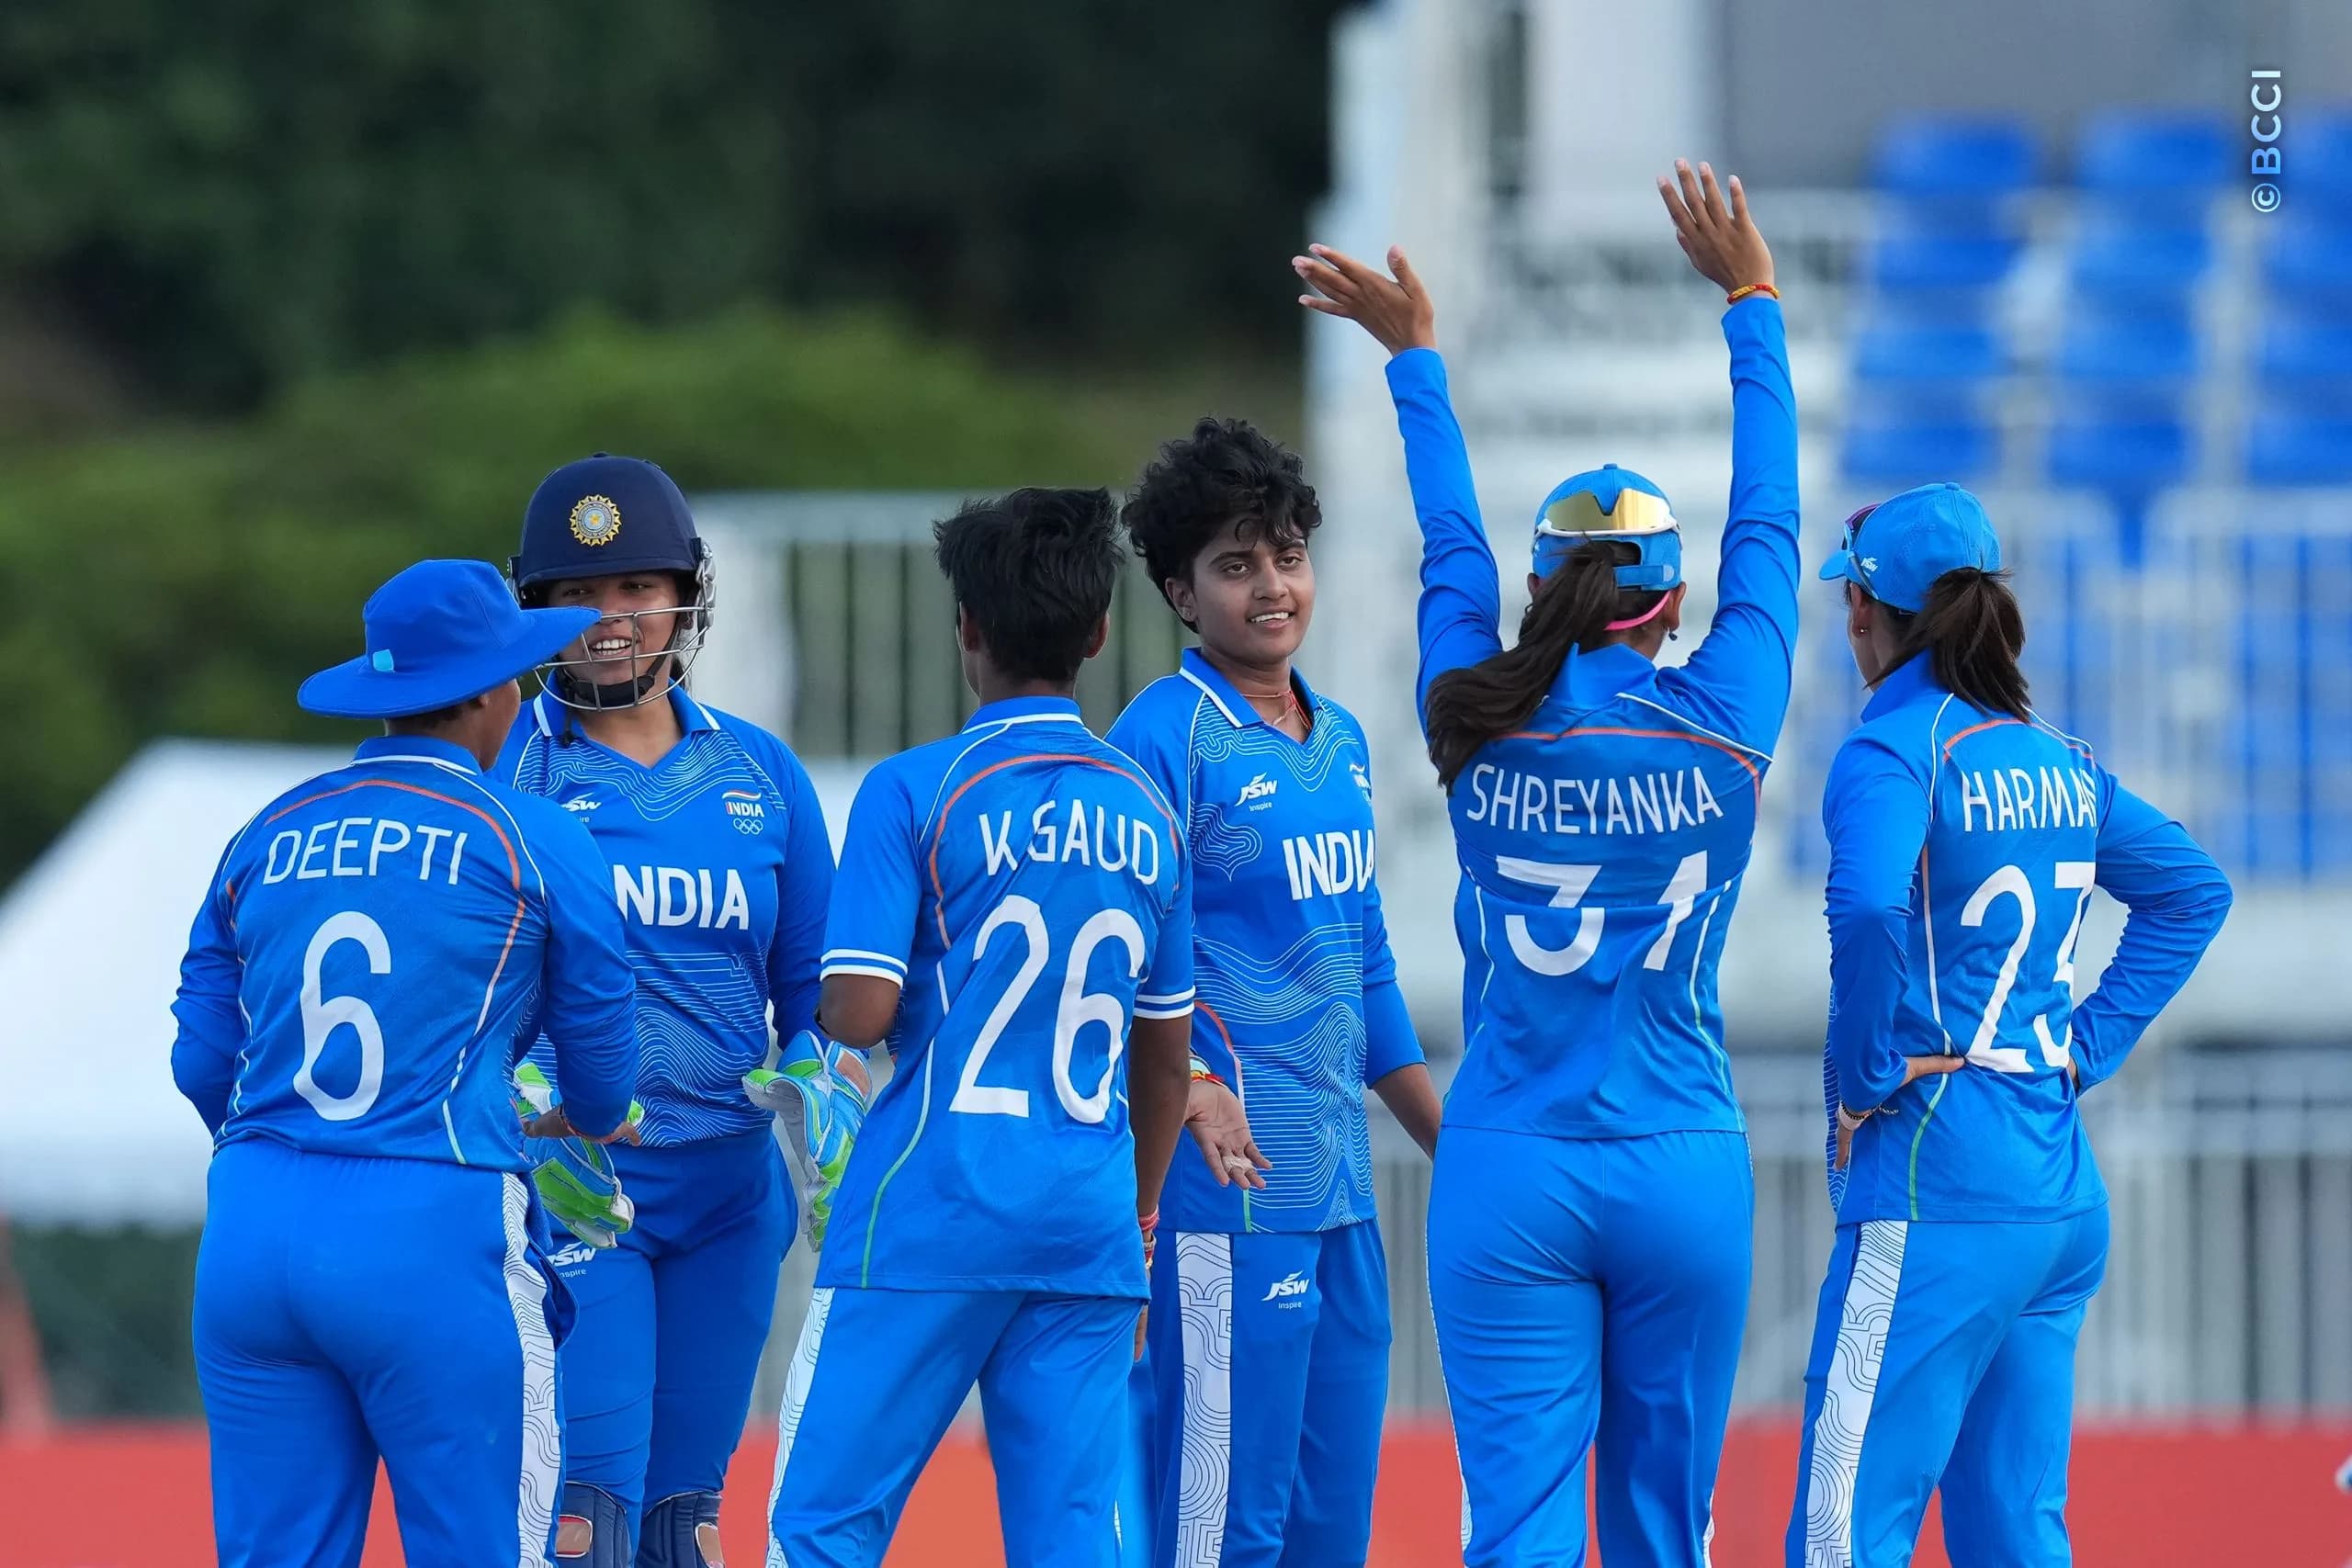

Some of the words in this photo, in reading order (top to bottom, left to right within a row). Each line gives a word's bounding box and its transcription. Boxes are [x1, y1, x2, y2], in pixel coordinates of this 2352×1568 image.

[725, 801, 764, 818] INDIA
[1235, 780, 1278, 807] JSW
[1466, 766, 1724, 835] SHREYANKA
[263, 817, 469, 885] DEEPTI
[613, 864, 750, 931] NDIA
[1496, 850, 1707, 976] 31
[1961, 862, 2097, 1073] 23
[292, 910, 391, 1121] 6
[948, 895, 1146, 1123] 26
[1261, 1278, 1310, 1301] JSW
